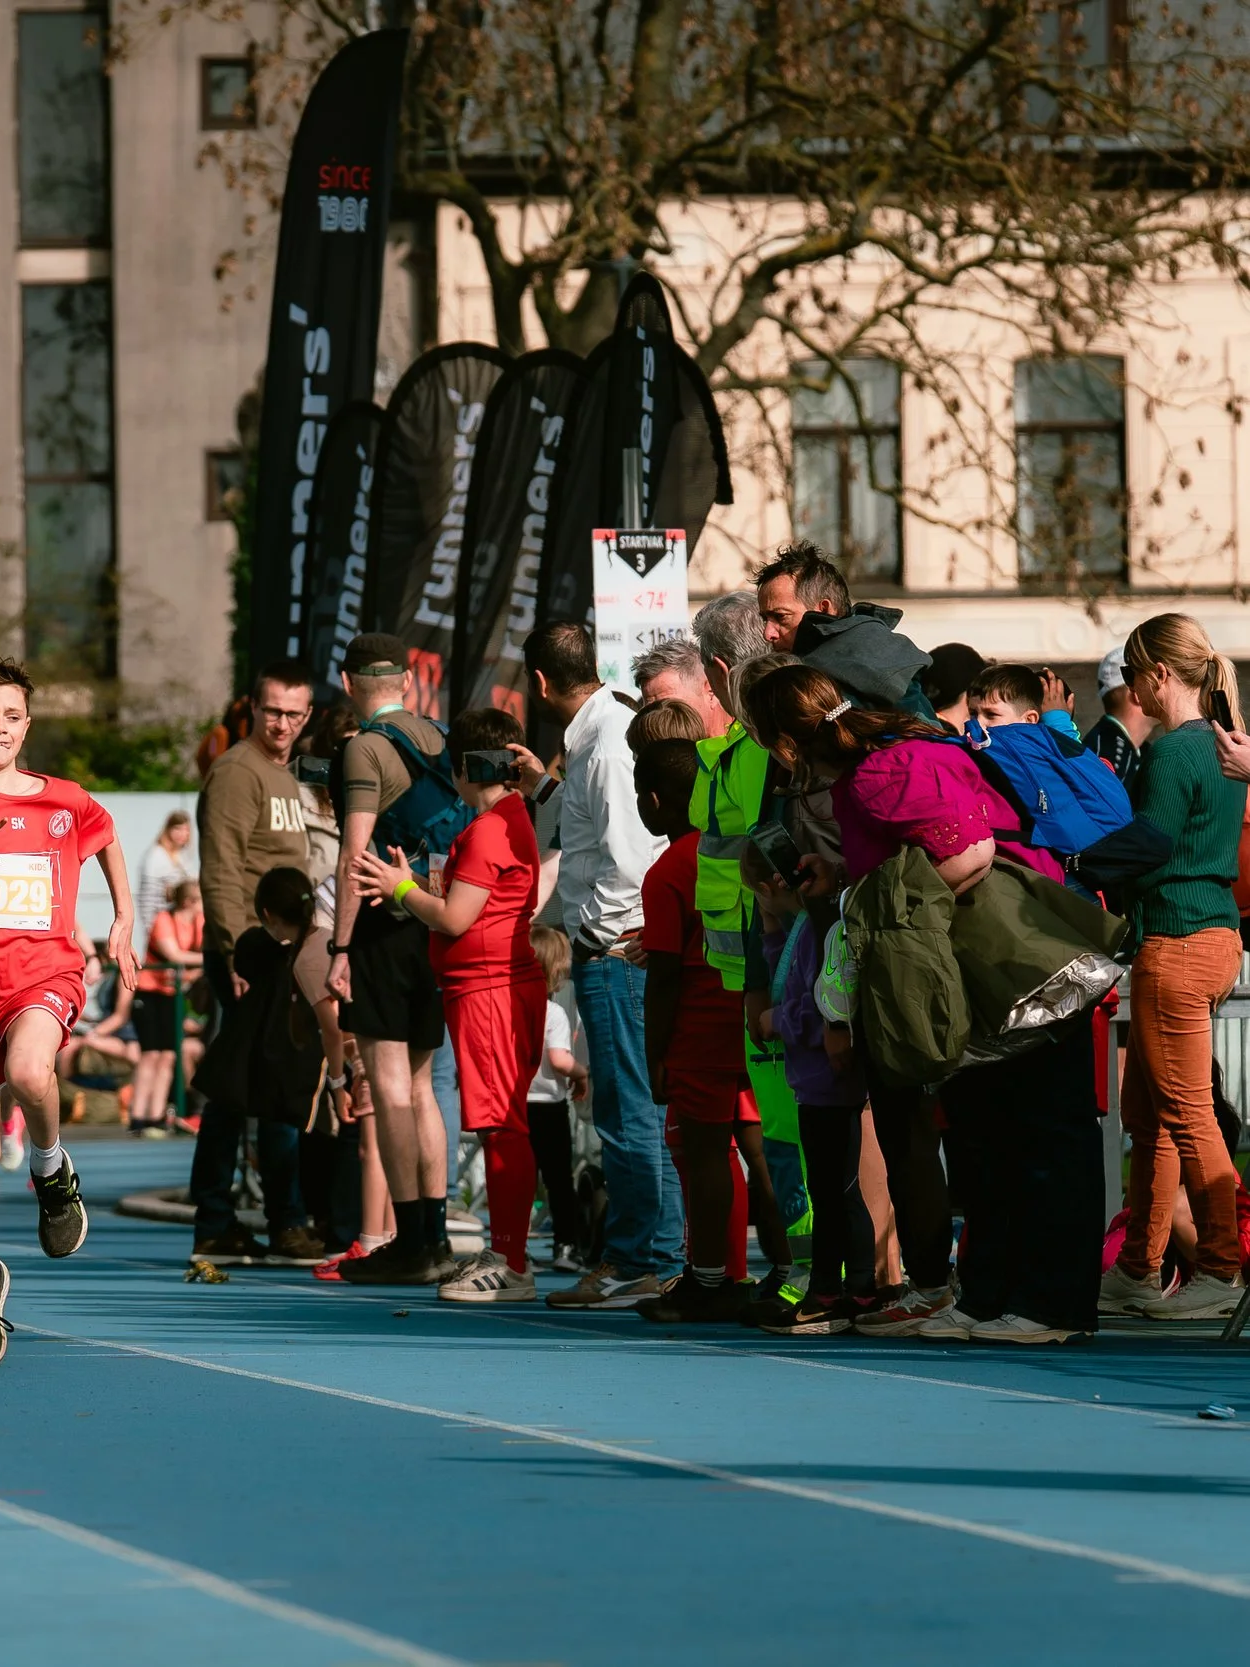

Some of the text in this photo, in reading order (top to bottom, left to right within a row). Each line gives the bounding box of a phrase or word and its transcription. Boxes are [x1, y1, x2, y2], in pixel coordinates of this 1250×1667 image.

[414, 387, 484, 630] runners'
[501, 396, 565, 662] runners'
[619, 535, 665, 549] STARTVAK
[636, 553, 646, 573] 3
[11, 817, 26, 829] SK
[29, 863, 47, 872] KIDS
